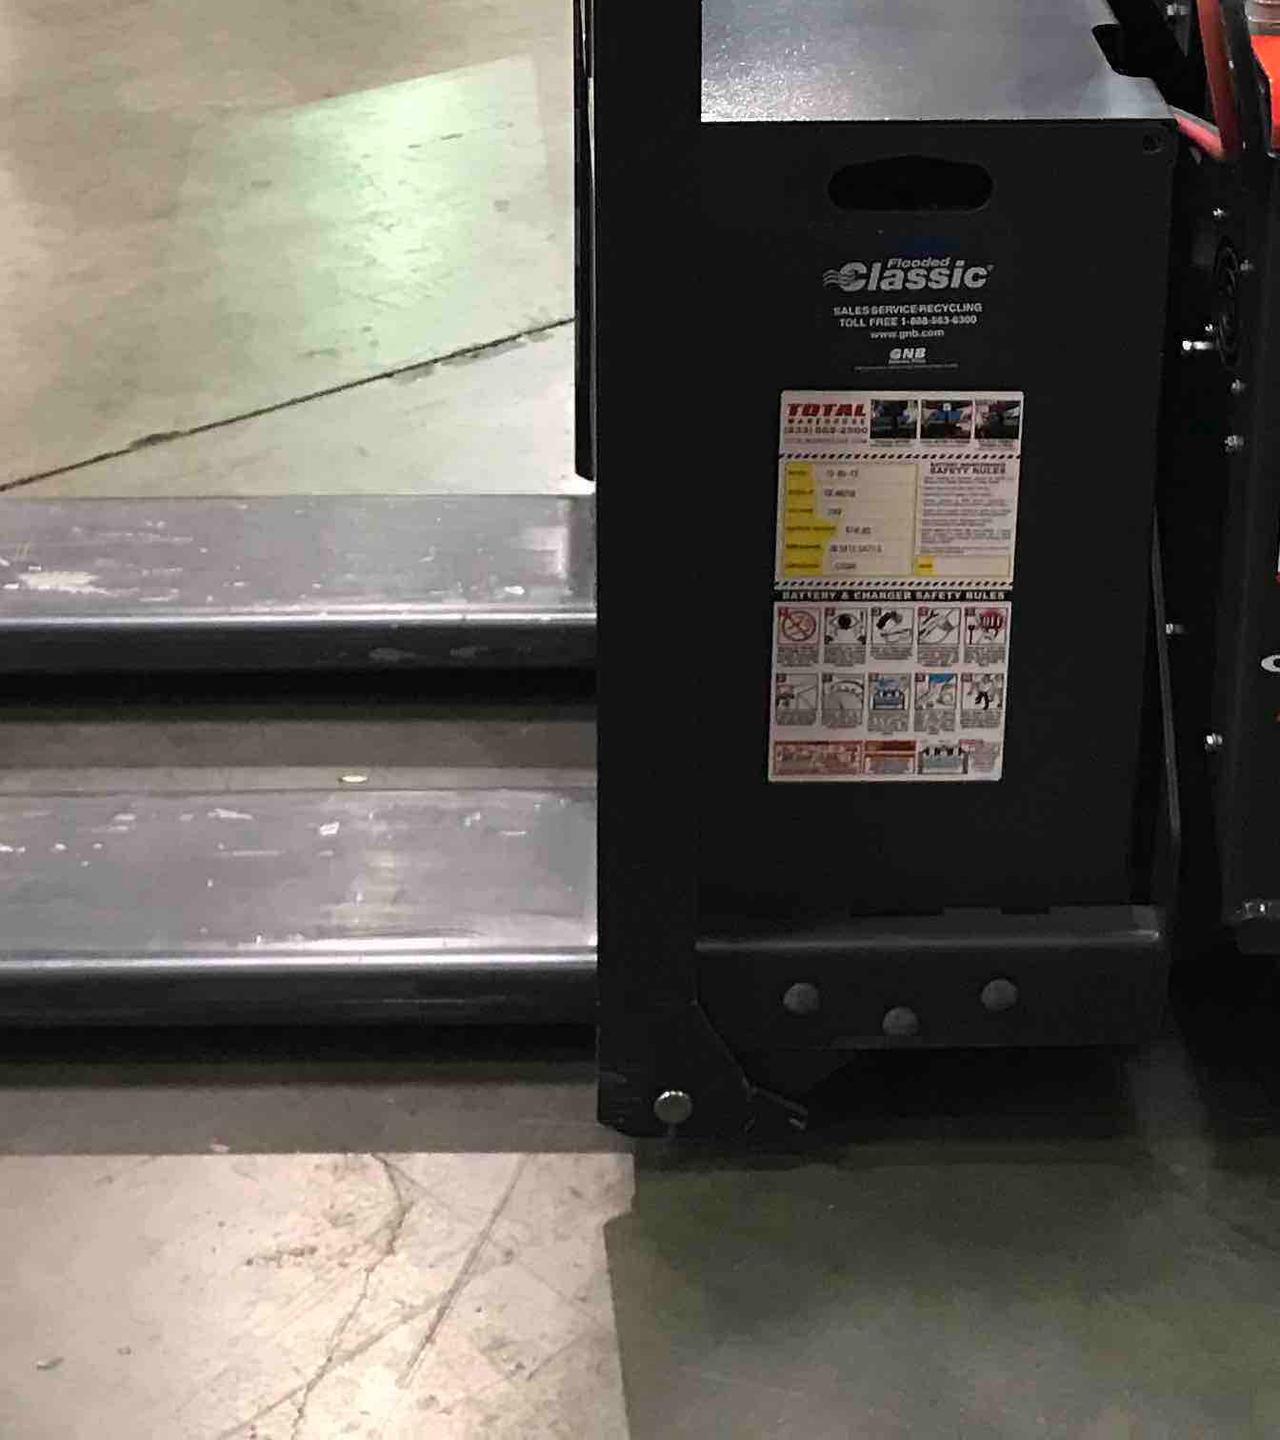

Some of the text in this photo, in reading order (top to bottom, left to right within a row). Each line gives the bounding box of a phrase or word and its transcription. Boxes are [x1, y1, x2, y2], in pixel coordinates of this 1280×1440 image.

[887, 257, 951, 269] Flooded
[837, 259, 988, 292] Classic
[839, 317, 867, 327] TOLL
[869, 316, 898, 326] FREE
[889, 347, 926, 359] GNB
[787, 403, 866, 416] TOTAL
[782, 591, 836, 600] BATTERY
[854, 591, 912, 600] CHARGER
[915, 591, 961, 600] SAFETY
[966, 591, 1005, 600] RULES
